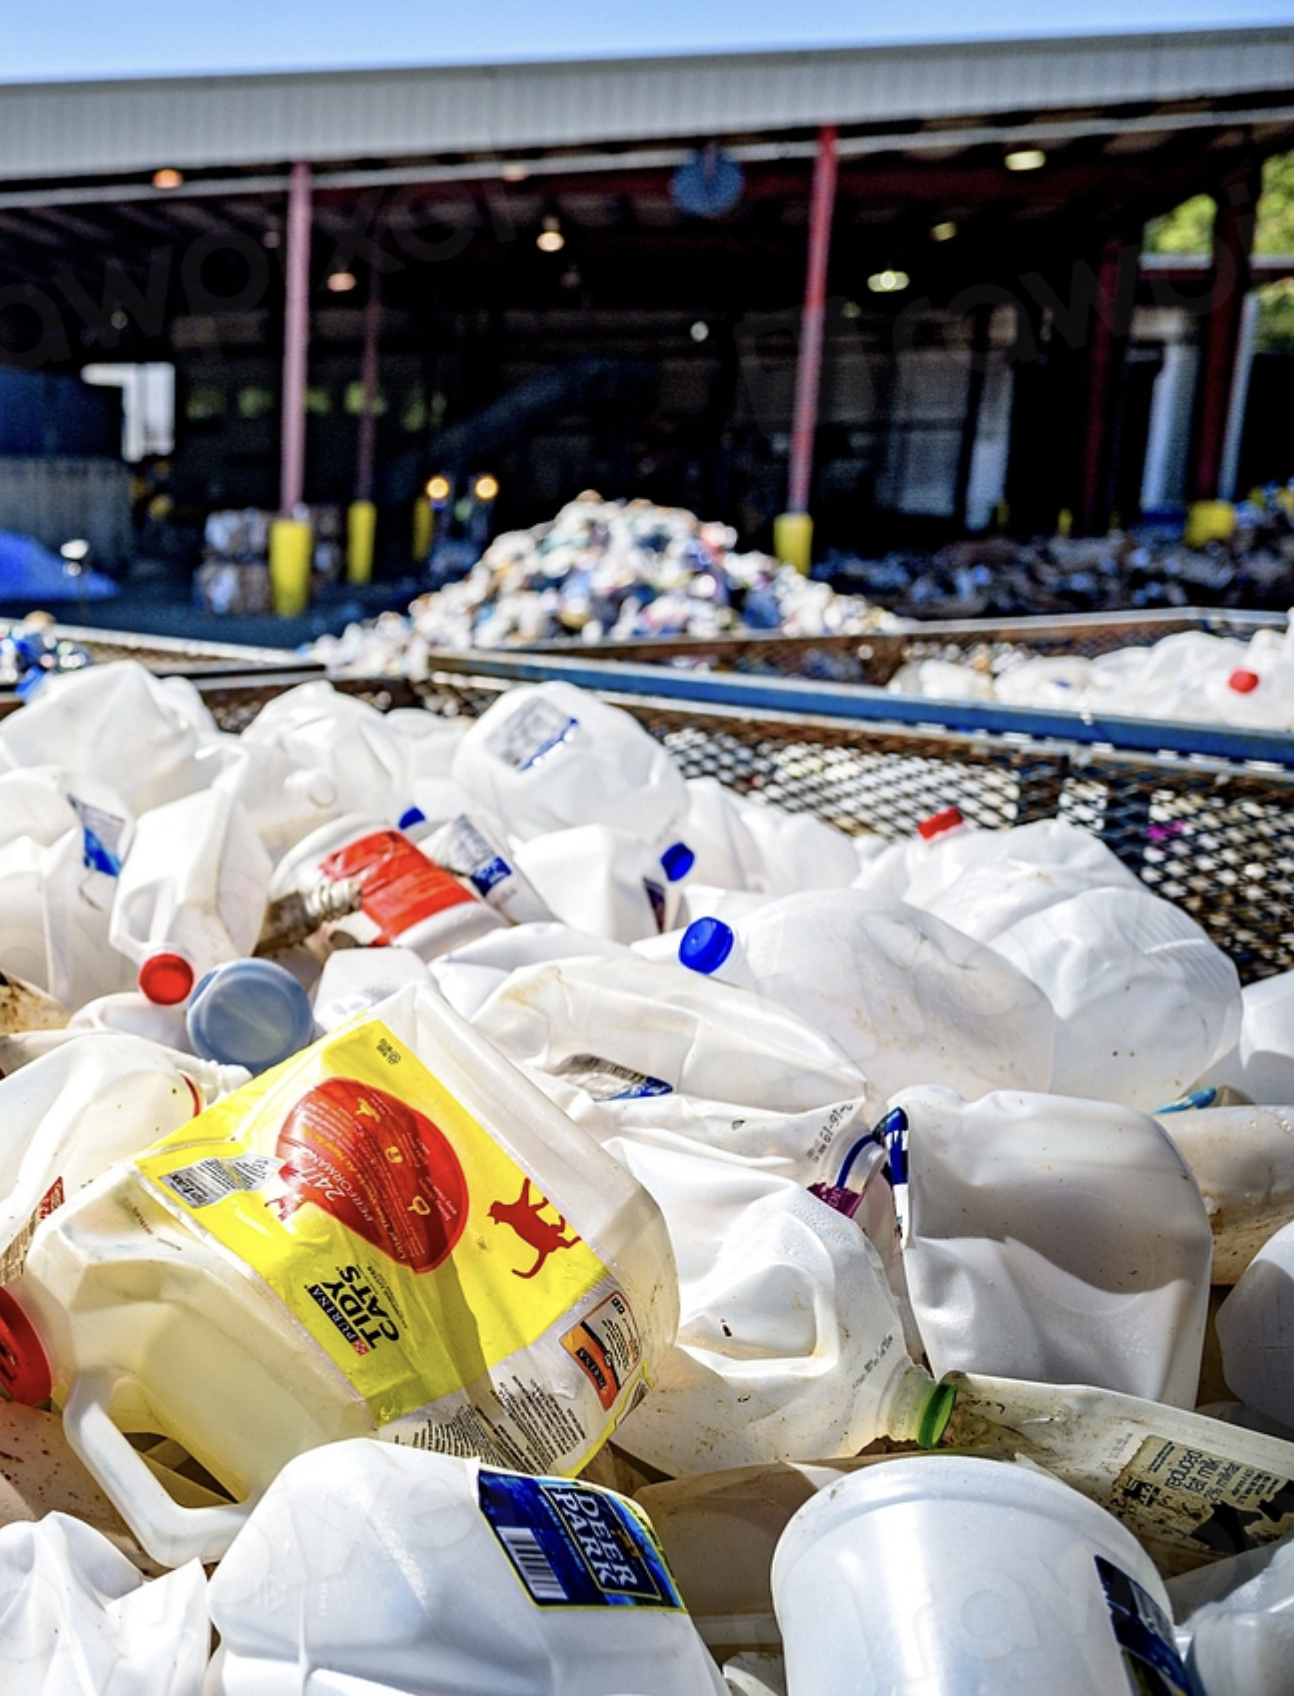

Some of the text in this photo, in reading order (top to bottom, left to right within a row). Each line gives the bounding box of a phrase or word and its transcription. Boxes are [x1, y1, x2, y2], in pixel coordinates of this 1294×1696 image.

[311, 1287, 357, 1341] PURINA
[320, 1282, 383, 1350] TIDY
[339, 1265, 400, 1342] CATS
[1164, 1448, 1203, 1490] reduced
[1196, 1457, 1224, 1479] milk
[551, 1489, 620, 1586] PARK
[573, 1490, 638, 1587] DEER
